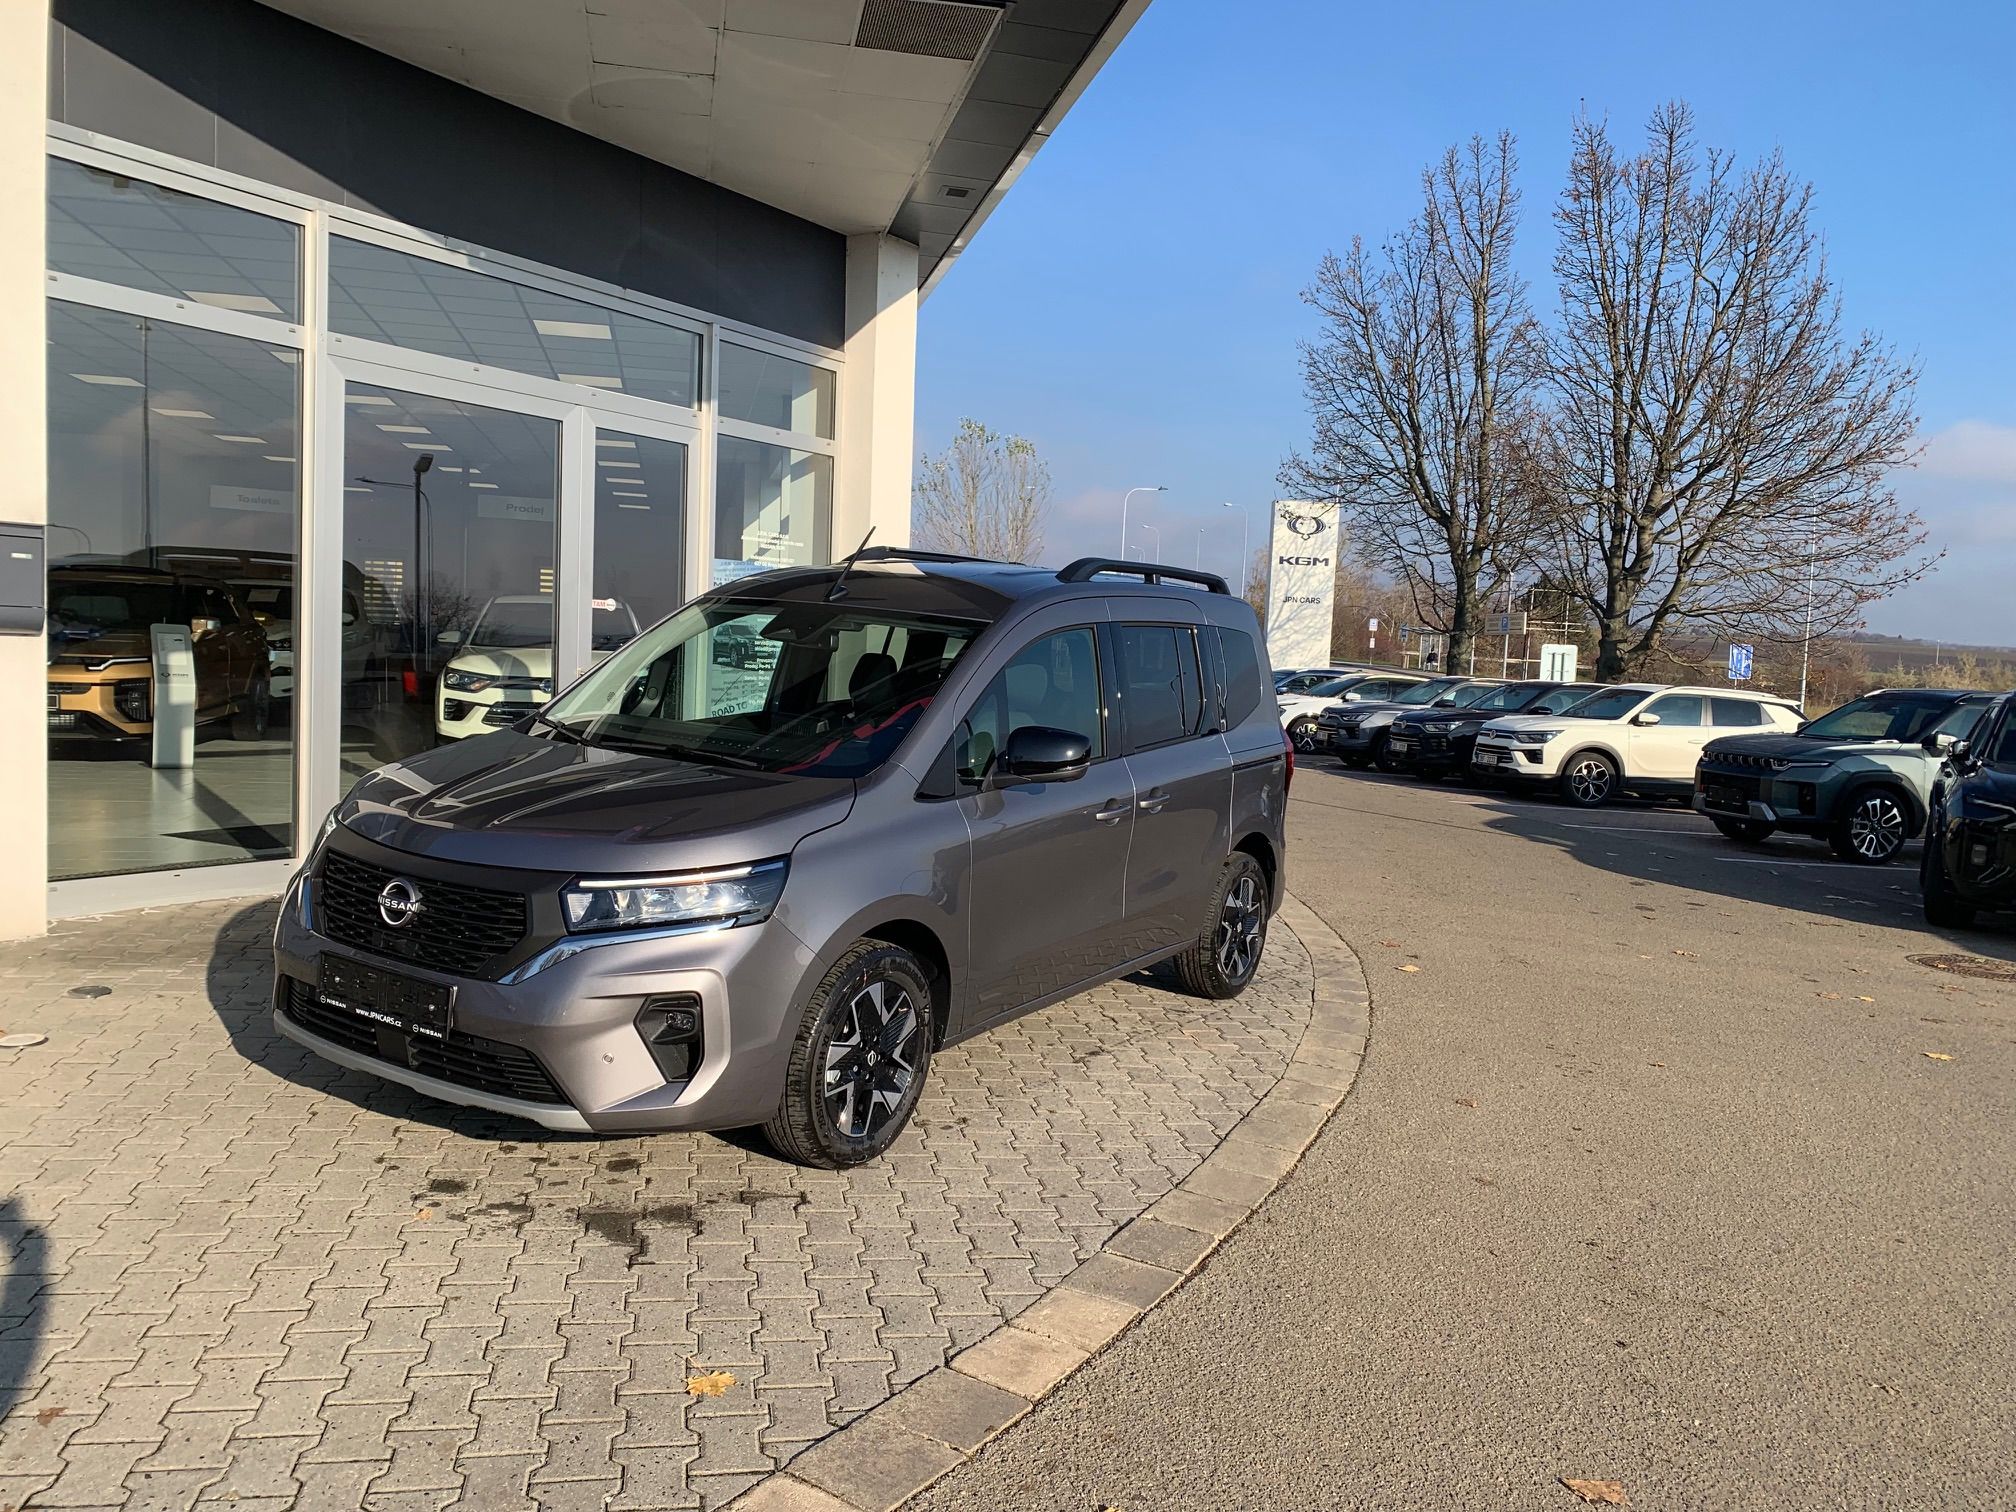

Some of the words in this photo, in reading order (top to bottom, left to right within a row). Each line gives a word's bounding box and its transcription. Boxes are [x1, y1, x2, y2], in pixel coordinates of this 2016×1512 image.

[506, 503, 544, 516] Prodej
[1279, 555, 1330, 567] KGM
[1283, 596, 1297, 604] JPN
[1300, 597, 1321, 605] CARS
[712, 705, 735, 718] ROAD
[377, 895, 419, 913] NISSAN
[327, 998, 347, 1009] NISSAN
[355, 1007, 402, 1028] www.JPNCARS.cz
[419, 1027, 442, 1039] NISSAN
